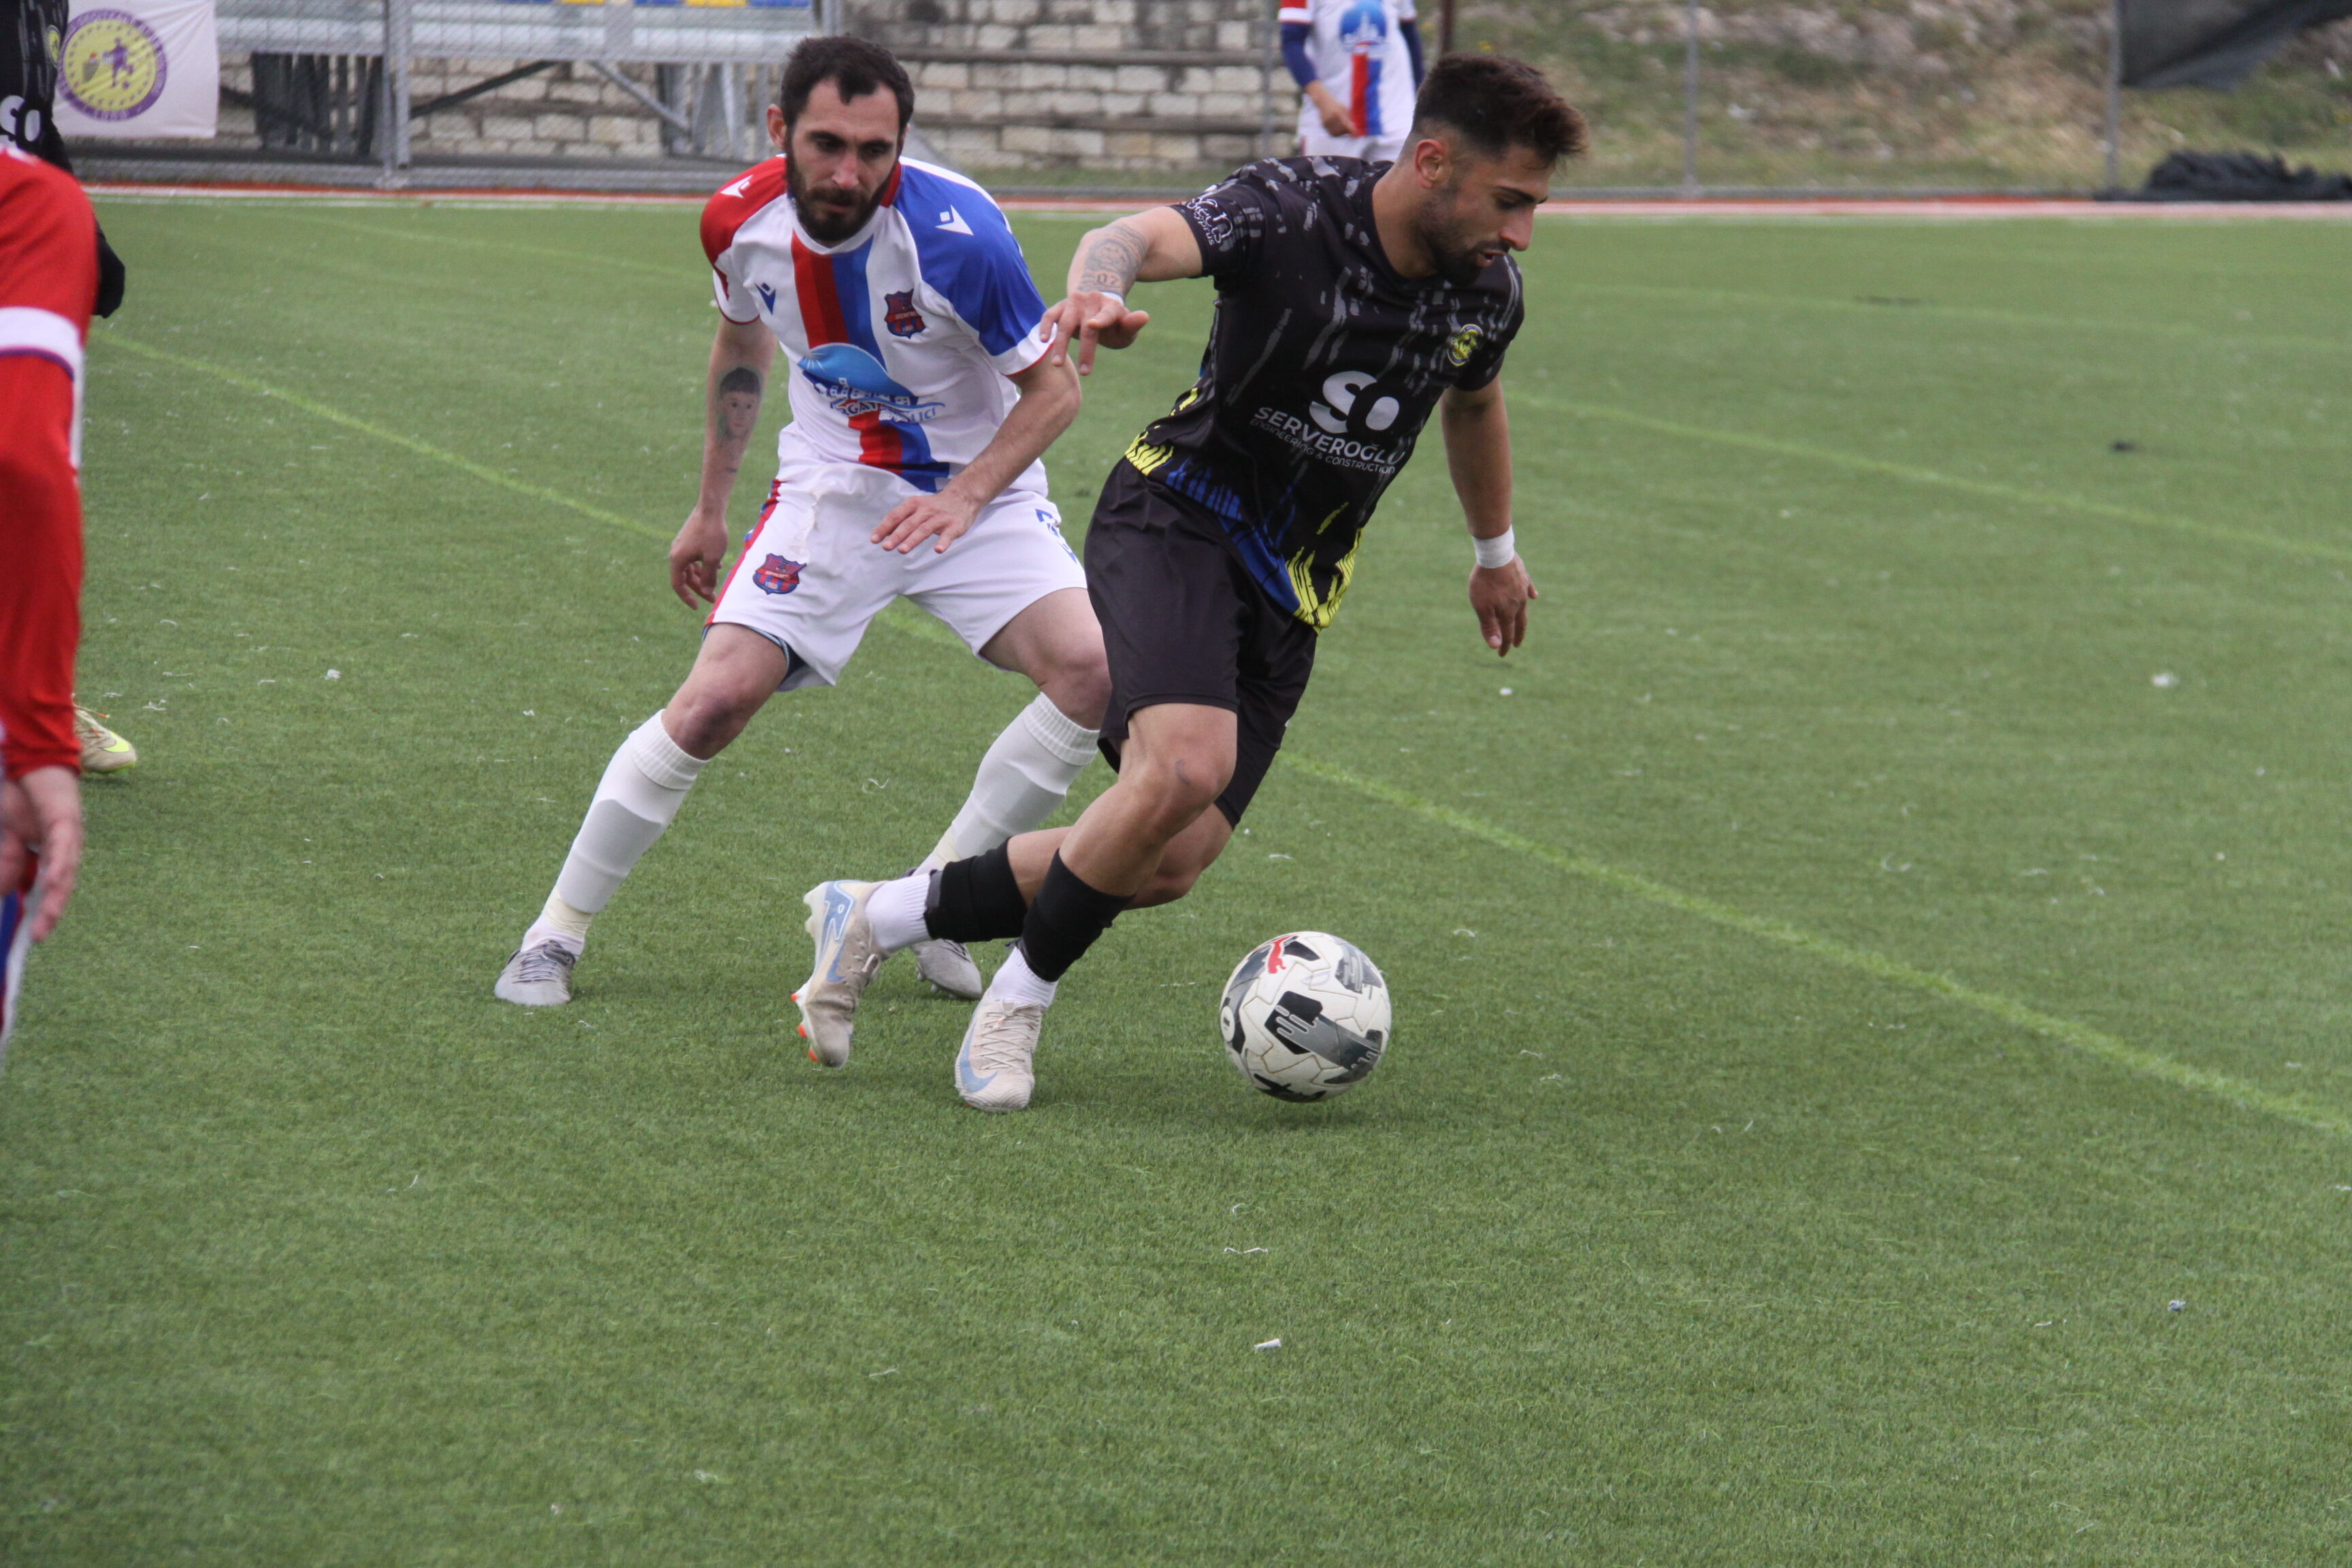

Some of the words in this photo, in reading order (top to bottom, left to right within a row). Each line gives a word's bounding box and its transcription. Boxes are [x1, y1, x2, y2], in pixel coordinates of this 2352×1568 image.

[1309, 370, 1400, 434] SO
[1254, 407, 1405, 464] SERVEROĞLU
[1325, 455, 1396, 474] CONSTRUCTION
